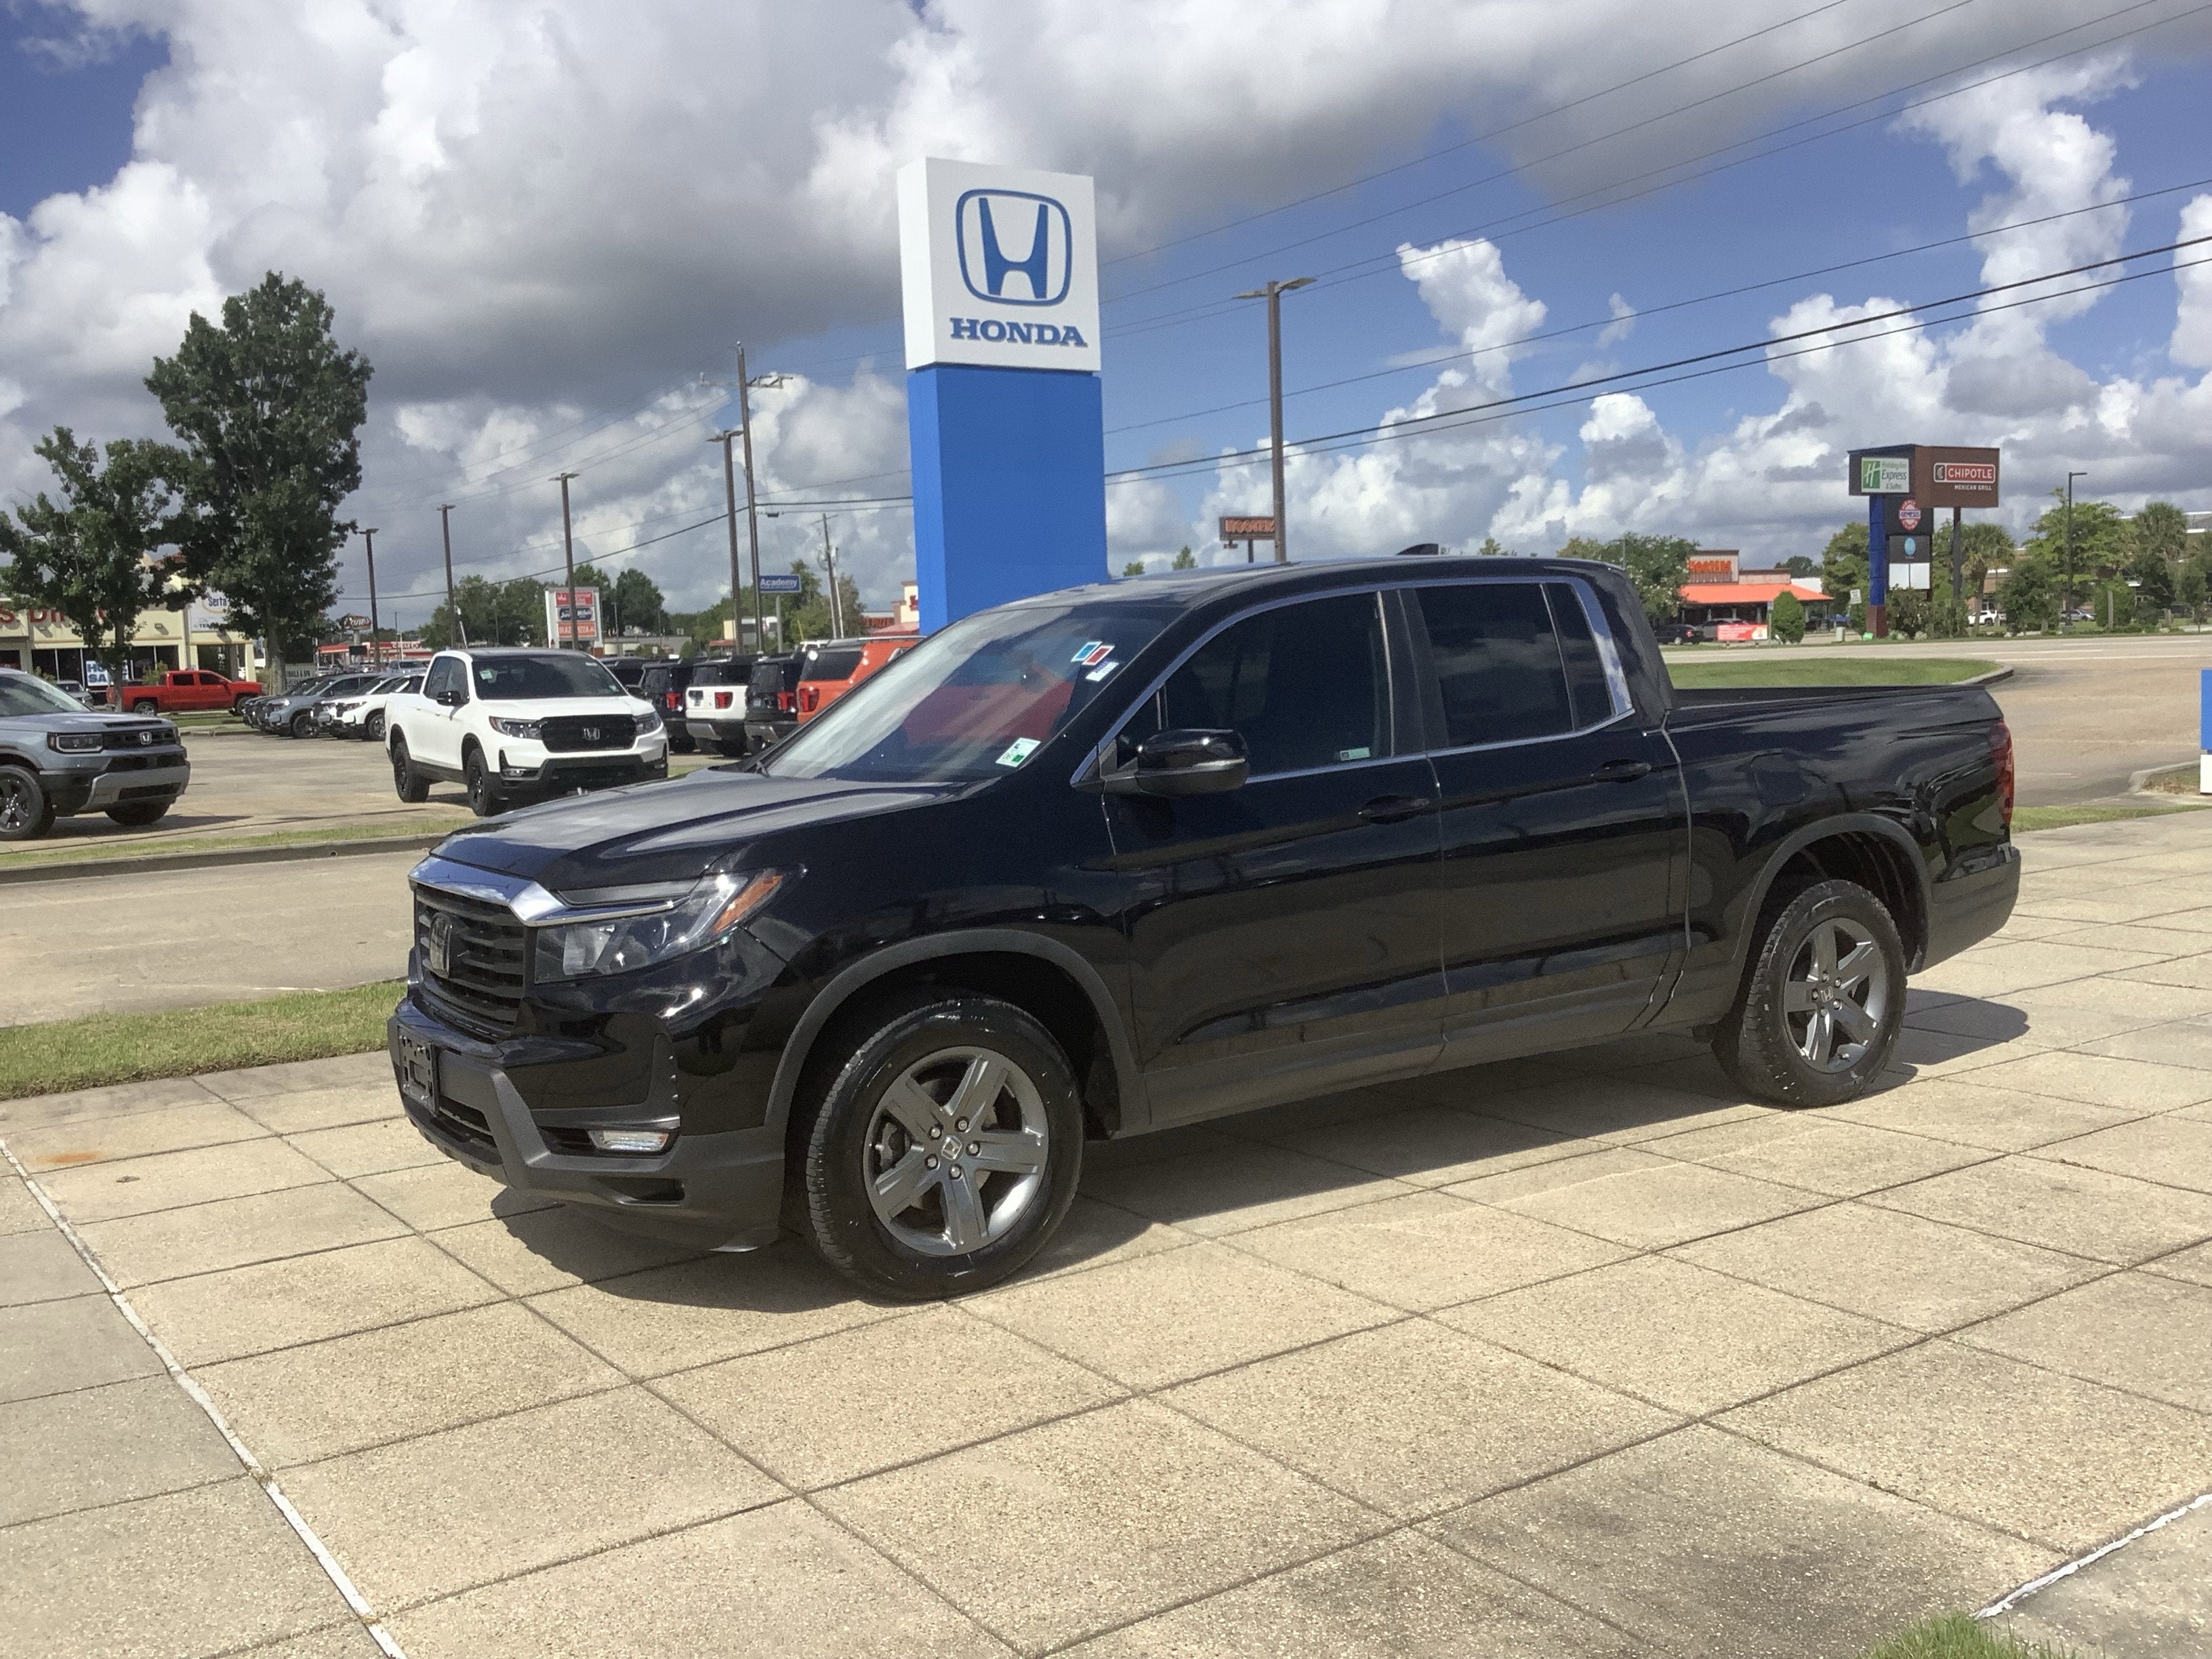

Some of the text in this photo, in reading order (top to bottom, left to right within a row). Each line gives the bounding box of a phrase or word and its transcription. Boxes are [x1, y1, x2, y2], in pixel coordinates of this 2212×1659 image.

[949, 317, 1088, 348] HONDA
[1881, 470, 1907, 482] Express
[1948, 468, 1992, 478] CHIPOTLE
[760, 578, 797, 588] Academy
[207, 596, 228, 607] Serta
